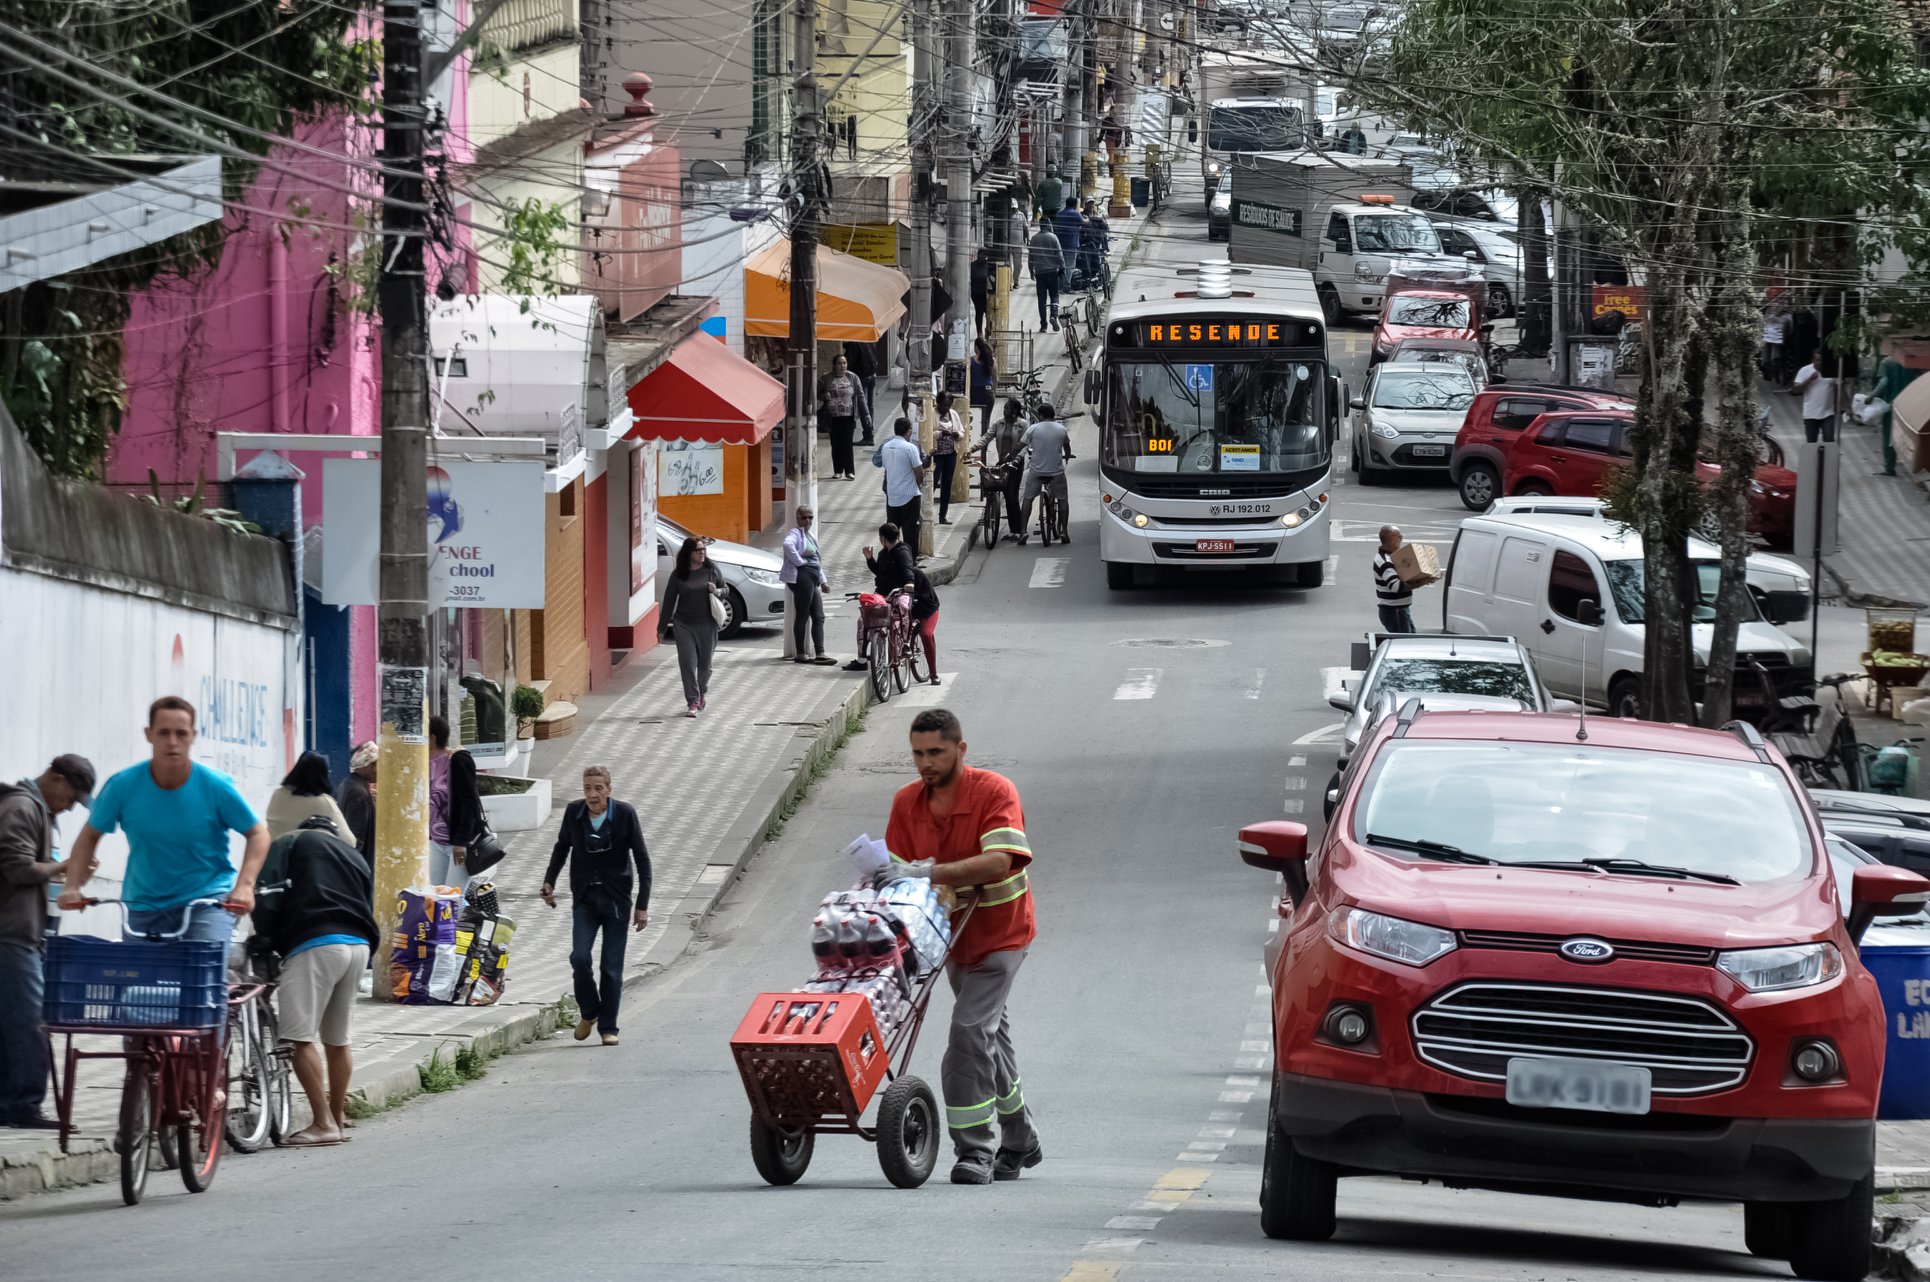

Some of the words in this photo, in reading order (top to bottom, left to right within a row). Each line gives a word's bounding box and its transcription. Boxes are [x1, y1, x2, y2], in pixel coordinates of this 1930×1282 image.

[1150, 325, 1280, 341] RESENDE
[1223, 505, 1235, 513] RJ
[1237, 504, 1271, 513] 192.012
[440, 546, 482, 560] ENGE
[449, 563, 495, 577] chool
[449, 586, 480, 596] -3037
[1573, 944, 1601, 956] Ford
